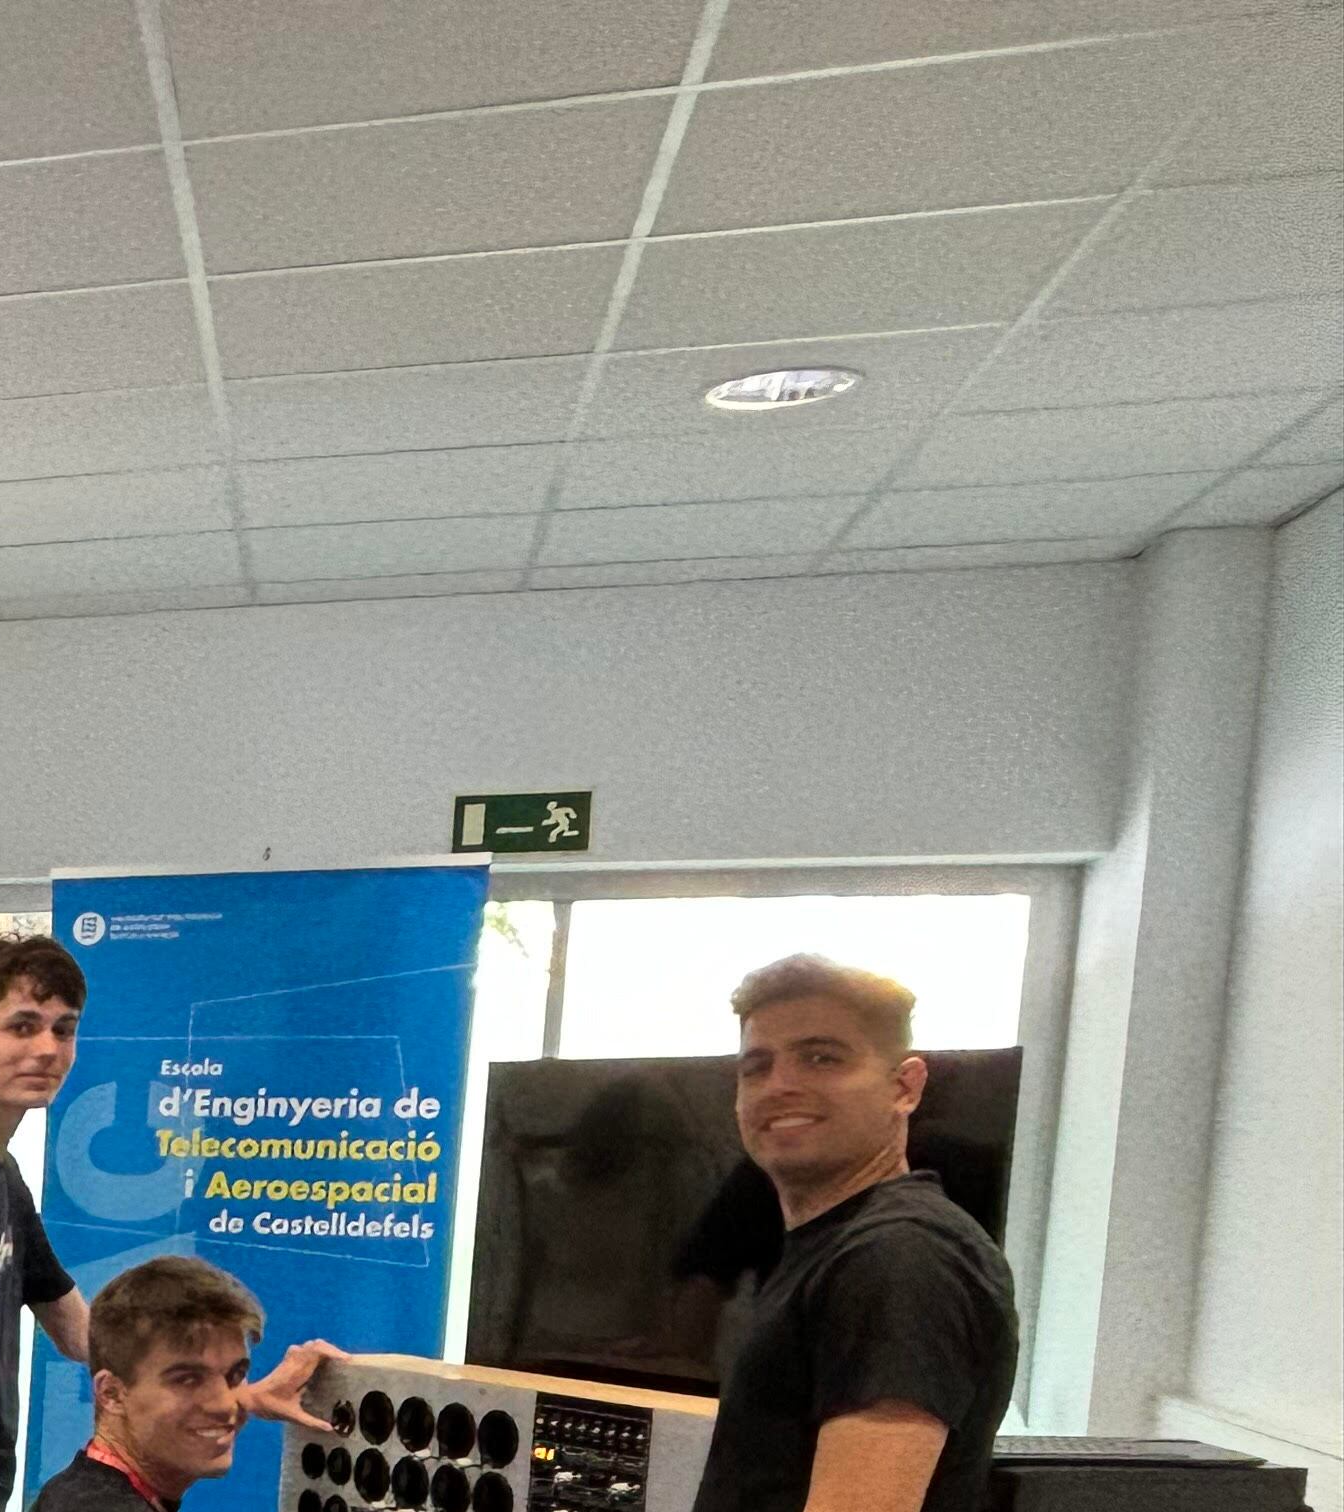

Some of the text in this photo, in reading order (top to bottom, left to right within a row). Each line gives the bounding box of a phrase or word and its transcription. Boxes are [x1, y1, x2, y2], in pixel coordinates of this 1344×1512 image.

[161, 1058, 224, 1077] Escola
[393, 1087, 441, 1120] de
[156, 1130, 441, 1161] Telecomunicació
[184, 1168, 438, 1210] i Aeroespacial
[208, 1208, 435, 1240] de Castelldefels
